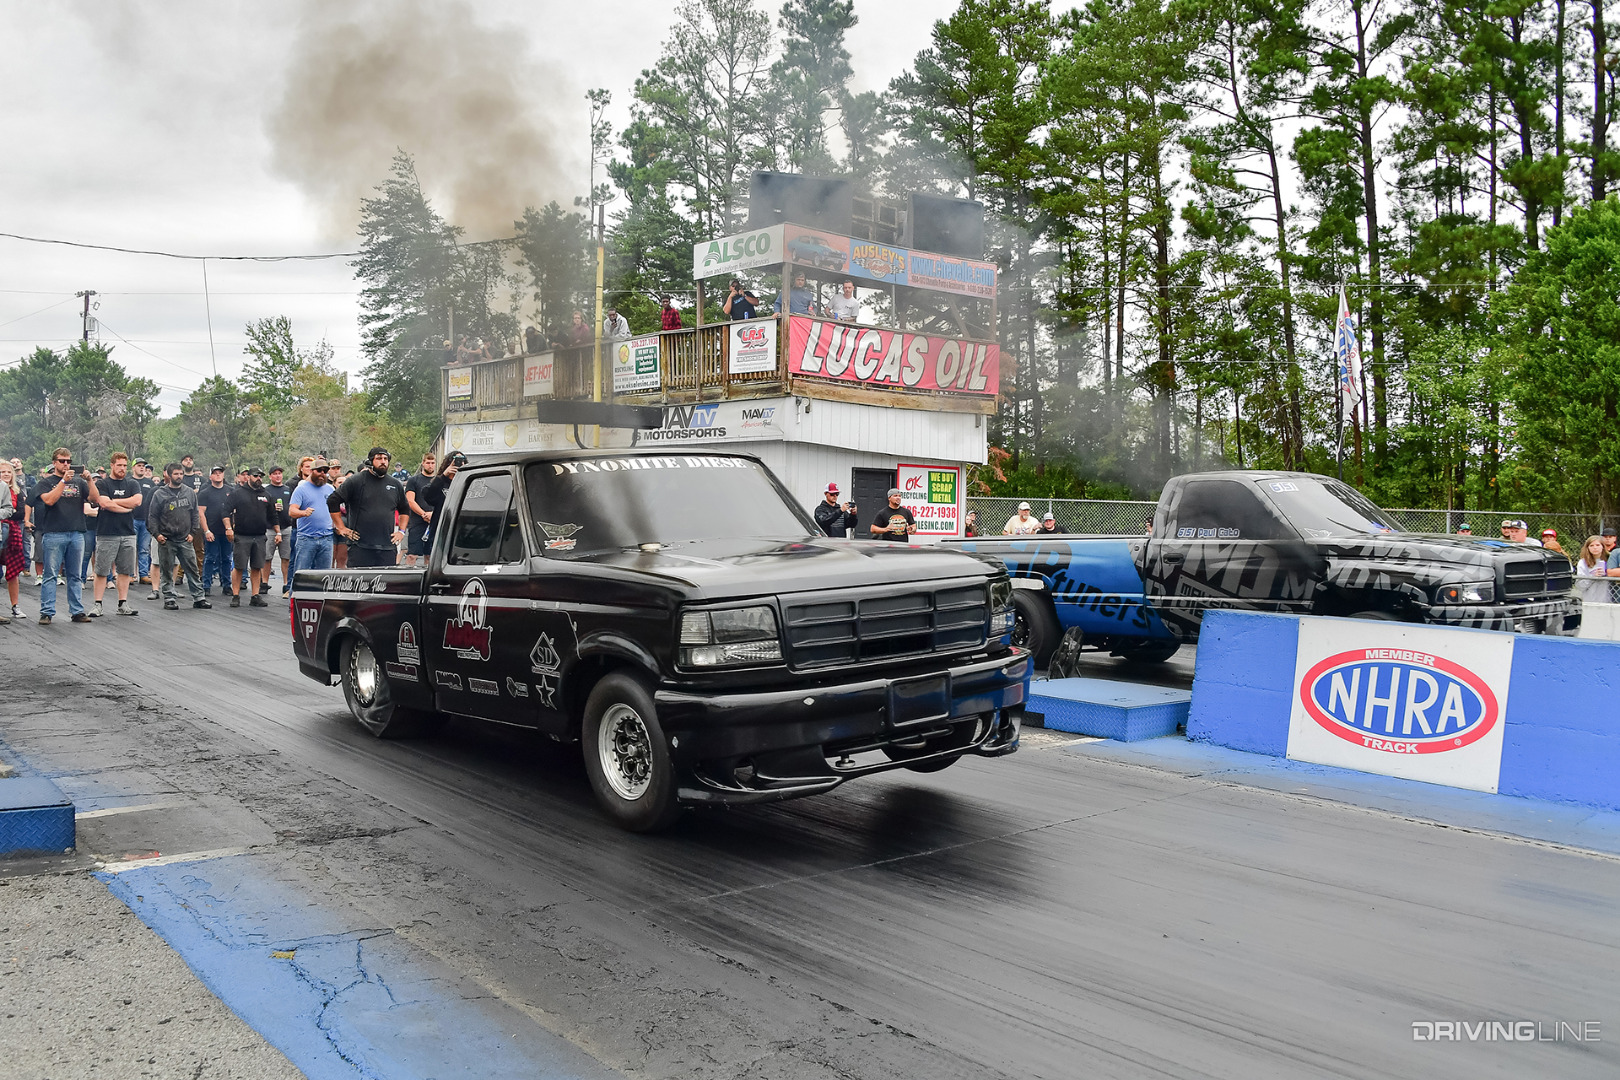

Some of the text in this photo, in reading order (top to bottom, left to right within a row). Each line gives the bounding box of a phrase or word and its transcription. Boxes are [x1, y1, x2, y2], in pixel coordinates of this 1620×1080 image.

[702, 233, 771, 267] ALSCO
[852, 245, 906, 270] AUSLEY'S
[800, 321, 988, 391] LUCAS OIL
[525, 364, 553, 382] JET-HOT
[742, 407, 776, 420] MAVTV
[643, 427, 727, 441] MOTORSPORTS
[682, 457, 757, 470] DIESE
[905, 475, 923, 491] OK
[930, 472, 955, 483] WE BUY
[931, 483, 953, 492] SCRAP
[1268, 482, 1300, 492] 6151
[900, 491, 927, 500] RECYCLING
[932, 493, 952, 503] METAL
[902, 505, 957, 518] 6-227-1938
[1177, 527, 1196, 538] 6151
[1198, 527, 1217, 538] Paul
[1051, 571, 1155, 629] tuners
[301, 607, 318, 623] DD
[305, 624, 314, 639] P
[537, 646, 552, 664] SD
[1365, 649, 1436, 667] MEMBER
[1327, 666, 1468, 736] NHRA
[1361, 735, 1419, 754] TRACK
